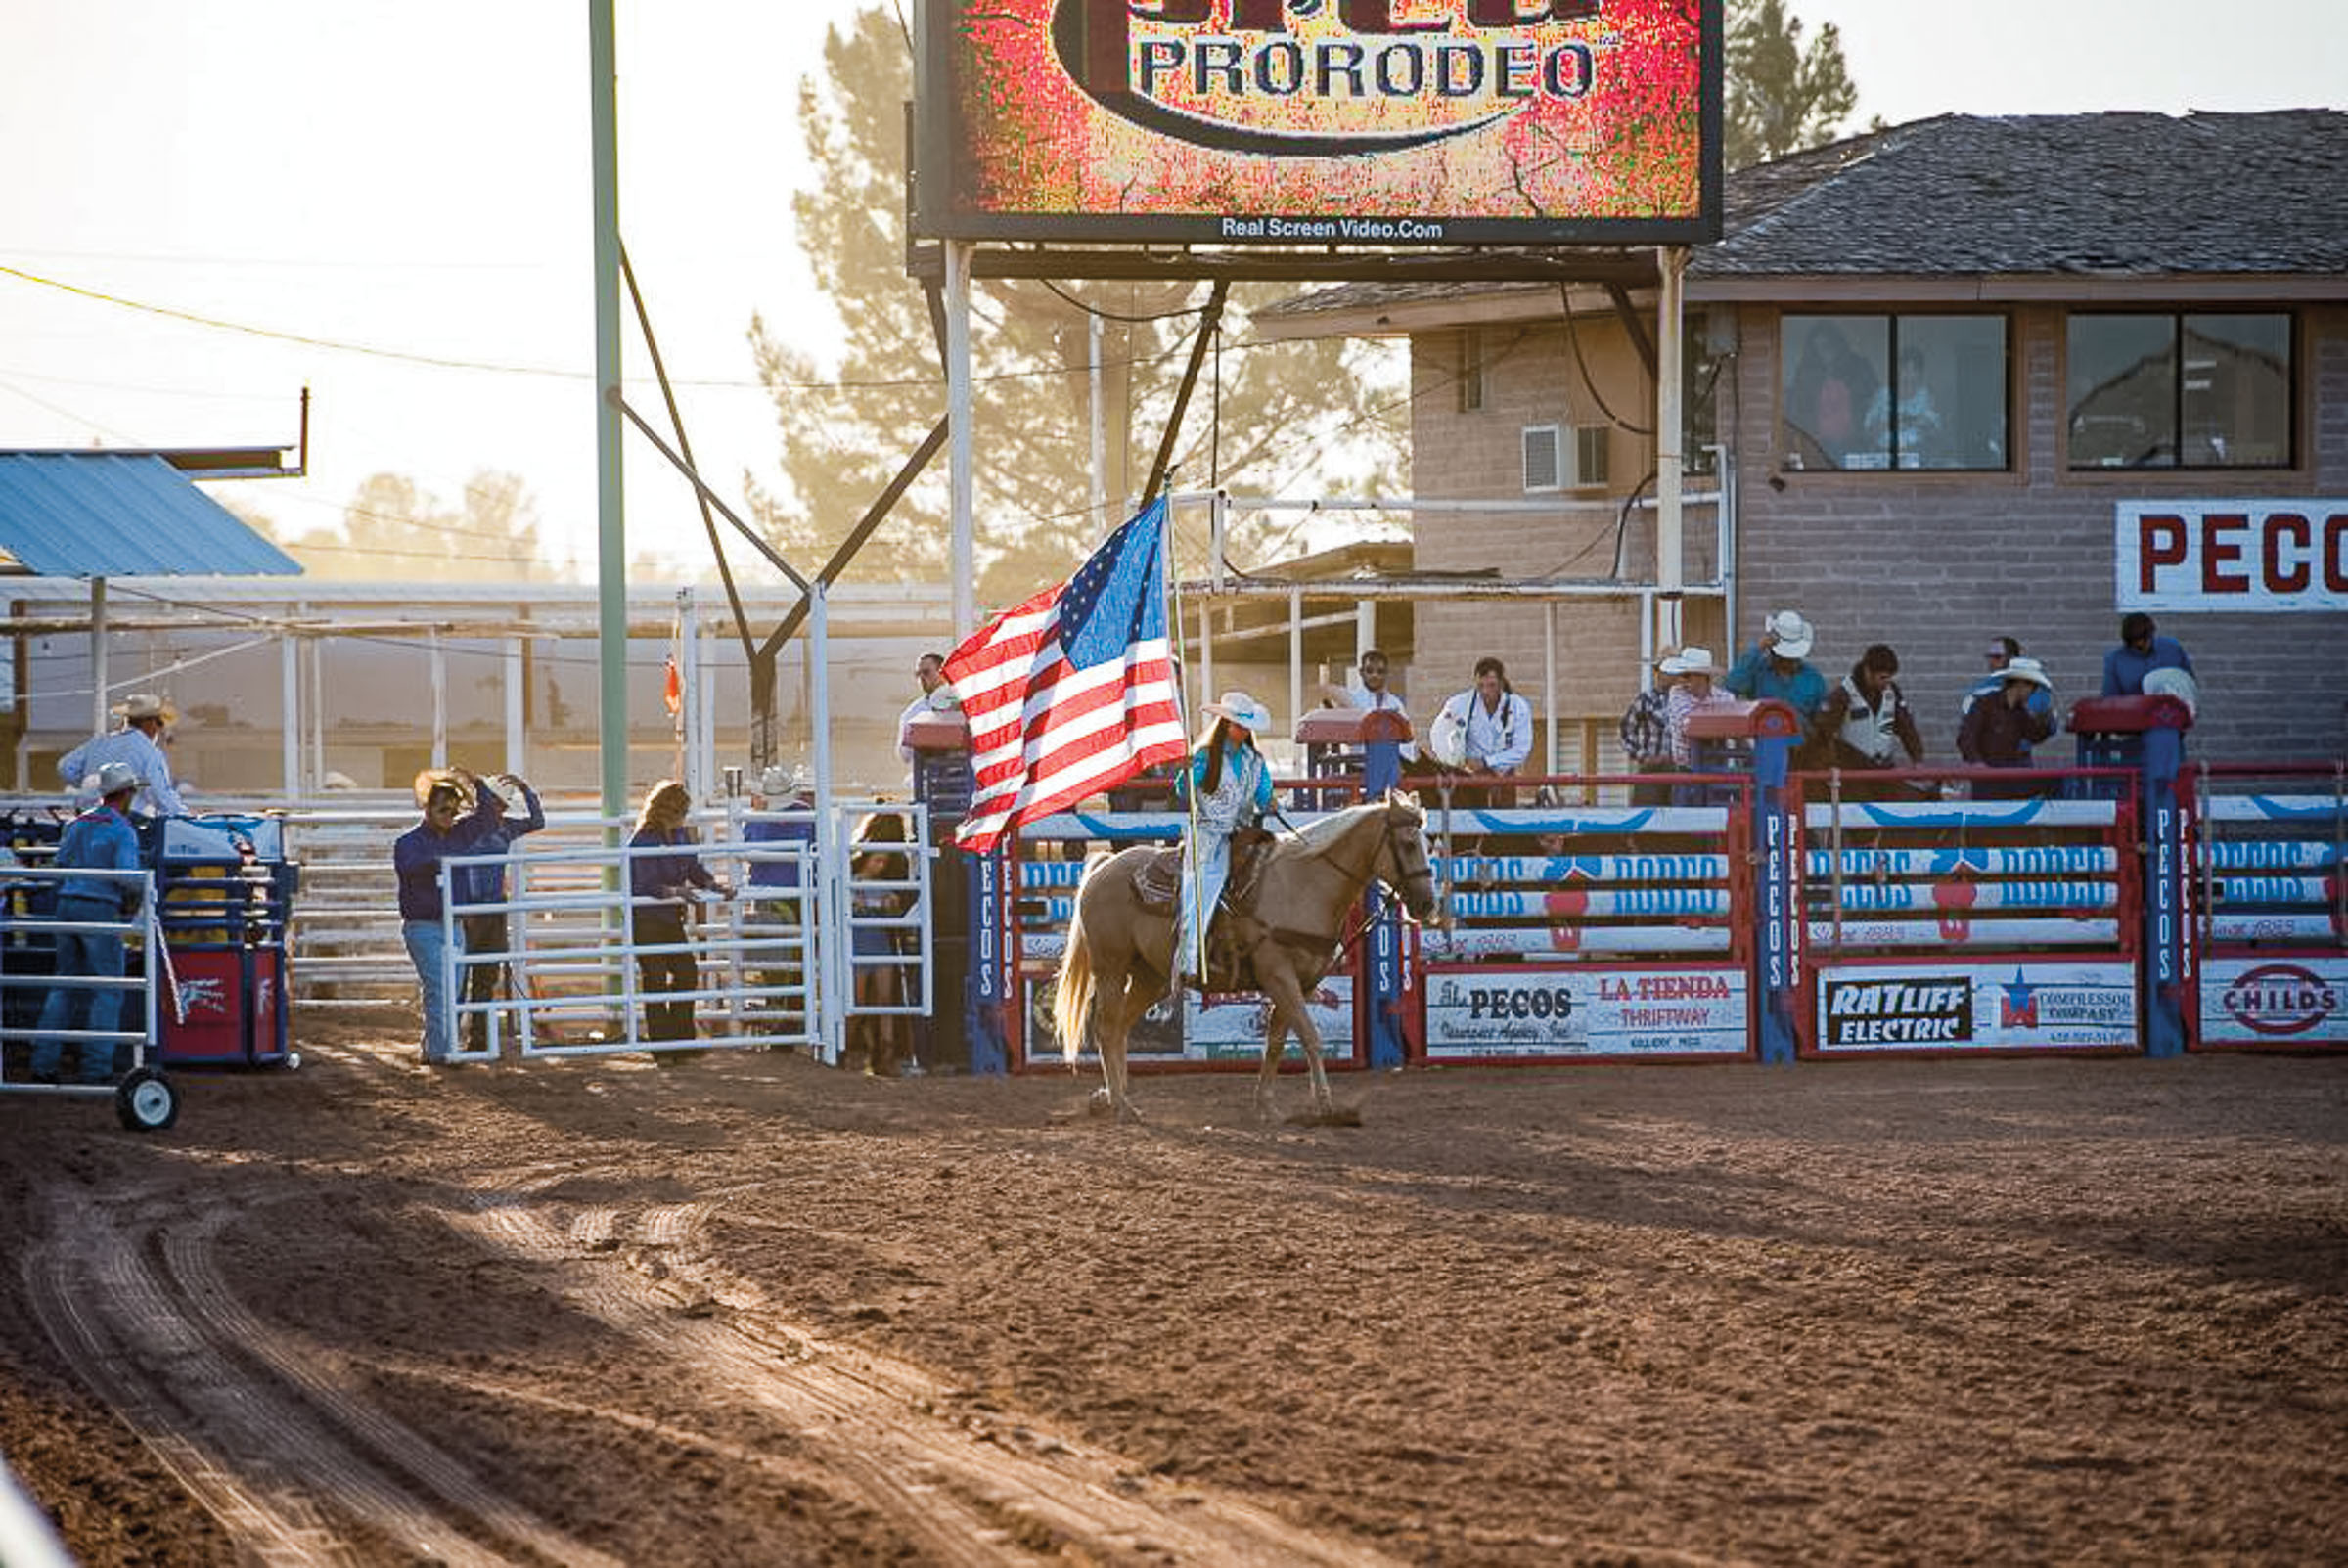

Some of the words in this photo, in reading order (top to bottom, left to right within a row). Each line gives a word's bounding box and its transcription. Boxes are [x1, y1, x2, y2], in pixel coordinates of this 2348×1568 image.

[1139, 37, 1595, 98] PRORODEO
[1222, 217, 1263, 237] Real
[1269, 218, 1335, 238] Screen
[1340, 219, 1442, 239] Video.Com
[1767, 815, 1781, 987] PECOS
[2157, 808, 2170, 980] PECOS
[980, 852, 992, 996] ECOS
[1469, 988, 1572, 1019] PECOS
[1600, 978, 1631, 1001] LA
[1637, 976, 1730, 1000] TIENDA
[1830, 983, 1966, 1015] RATLIFF
[2223, 989, 2336, 1011] CHILDS
[1620, 1008, 1710, 1027] THRIFTWAY
[1840, 1017, 1959, 1043] ELECTRIC
